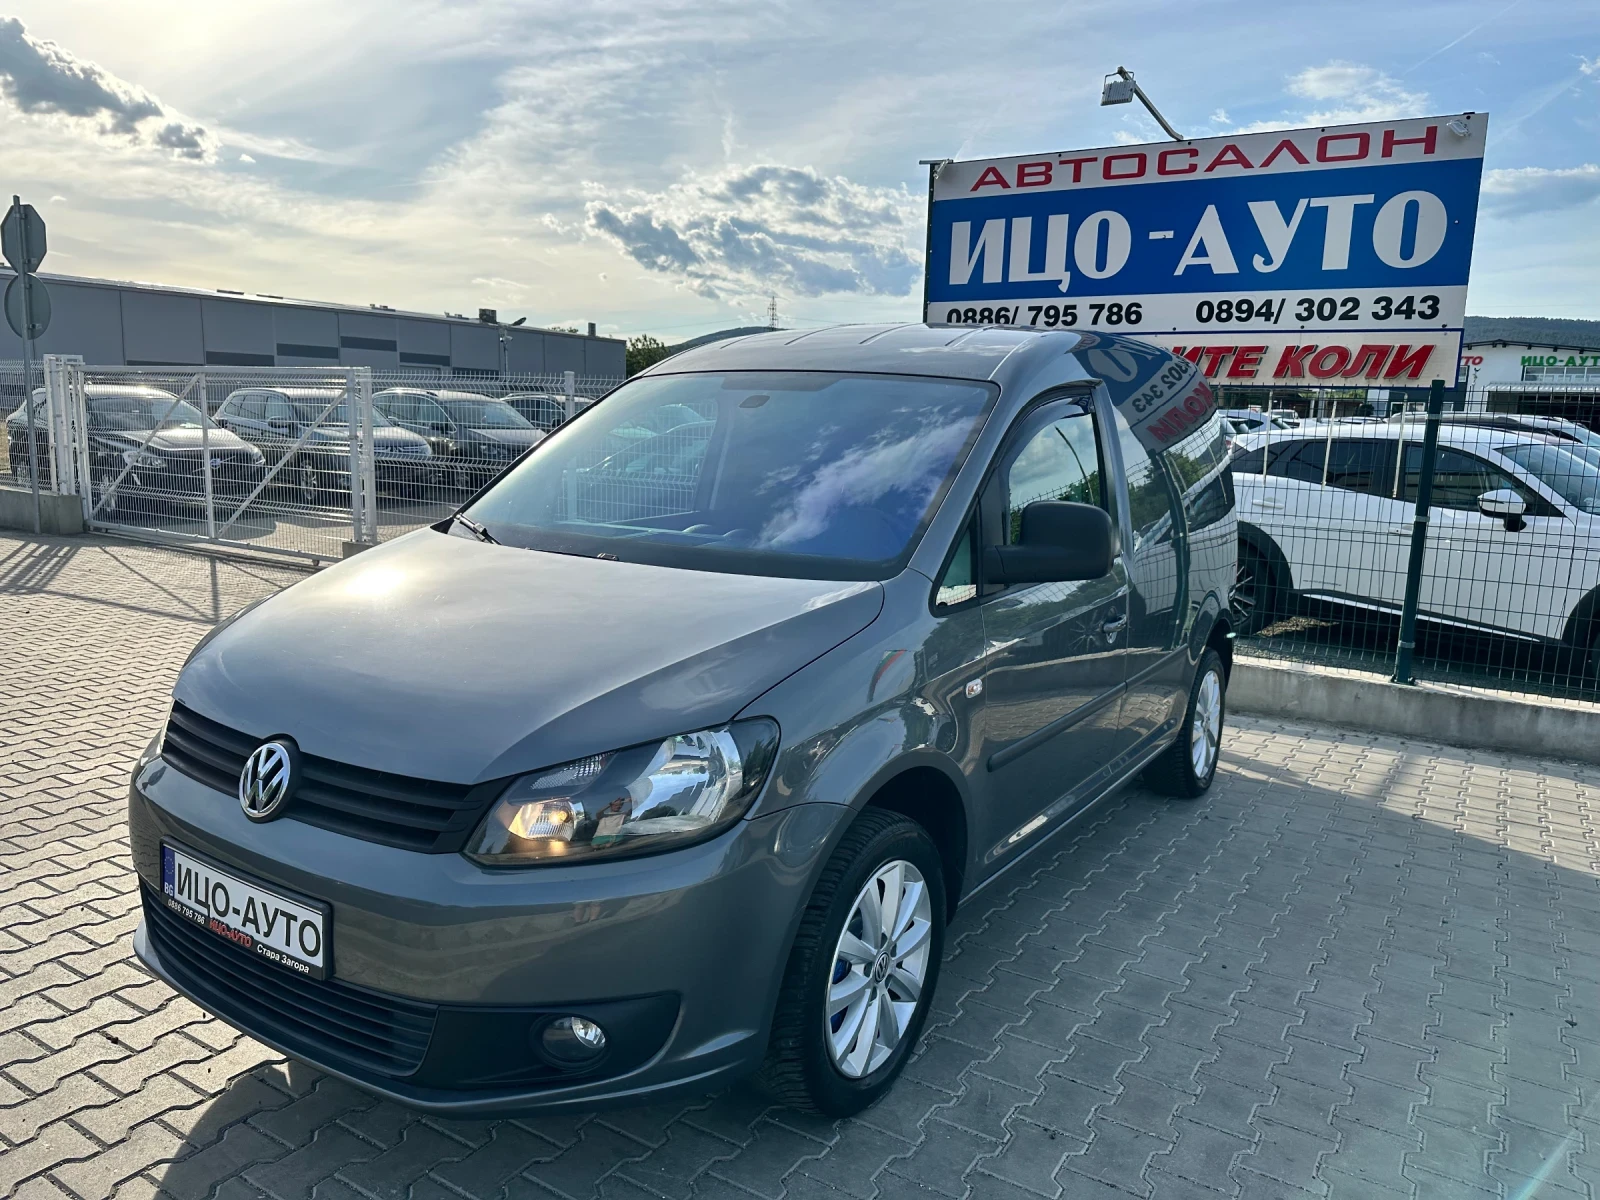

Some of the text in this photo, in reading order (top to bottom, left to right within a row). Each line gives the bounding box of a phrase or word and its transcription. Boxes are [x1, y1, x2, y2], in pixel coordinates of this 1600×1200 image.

[970, 126, 1438, 192] АВТОСАЛОН
[1028, 304, 1078, 327] 795
[1089, 302, 1143, 325] 786
[1195, 295, 1440, 325] 0894/ 302 343
[1272, 344, 1436, 380] КОЛИ
[164, 882, 174, 896] BG
[177, 863, 321, 958] ИЦО-АУТО
[183, 905, 193, 918] 795
[194, 911, 205, 925] 786
[257, 943, 280, 960] Стара
[281, 954, 310, 974] Загора
